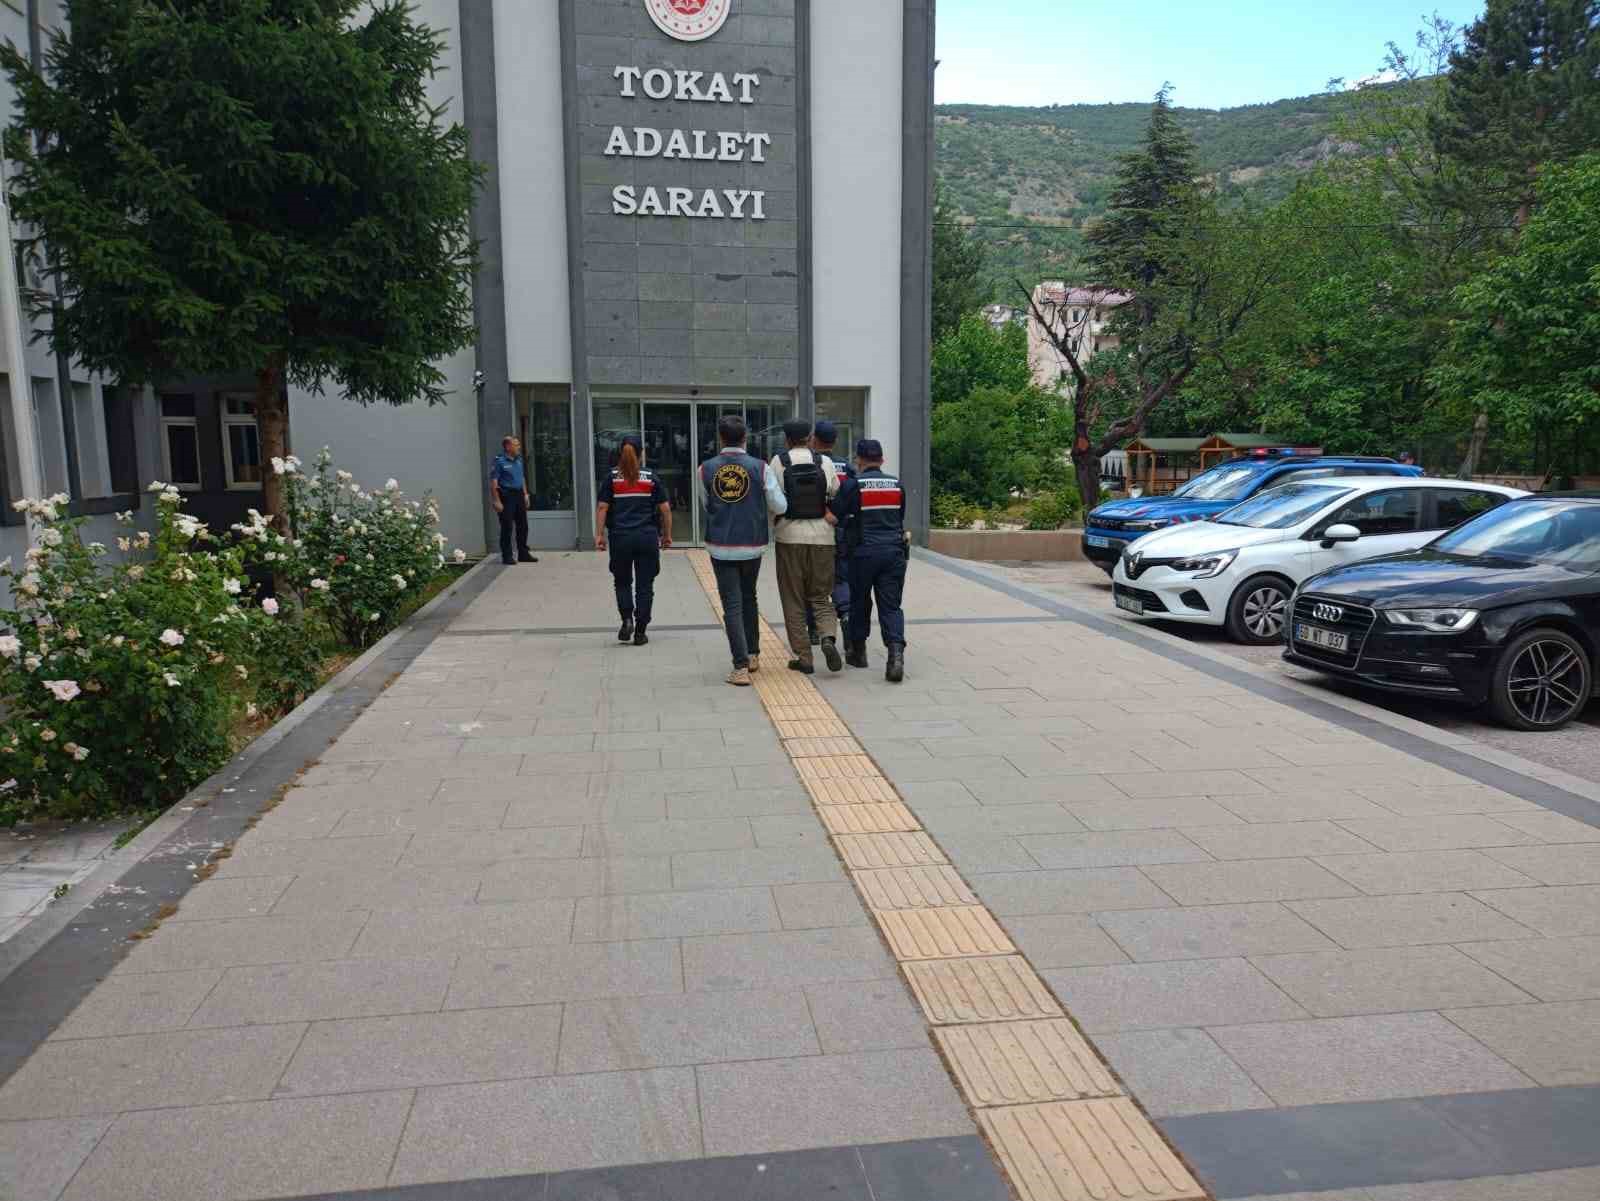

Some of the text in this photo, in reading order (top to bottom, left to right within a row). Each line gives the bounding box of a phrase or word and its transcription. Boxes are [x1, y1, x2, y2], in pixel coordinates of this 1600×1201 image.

[614, 66, 760, 103] TOKAT
[604, 126, 770, 162] ADALET
[612, 185, 766, 219] SARAYI
